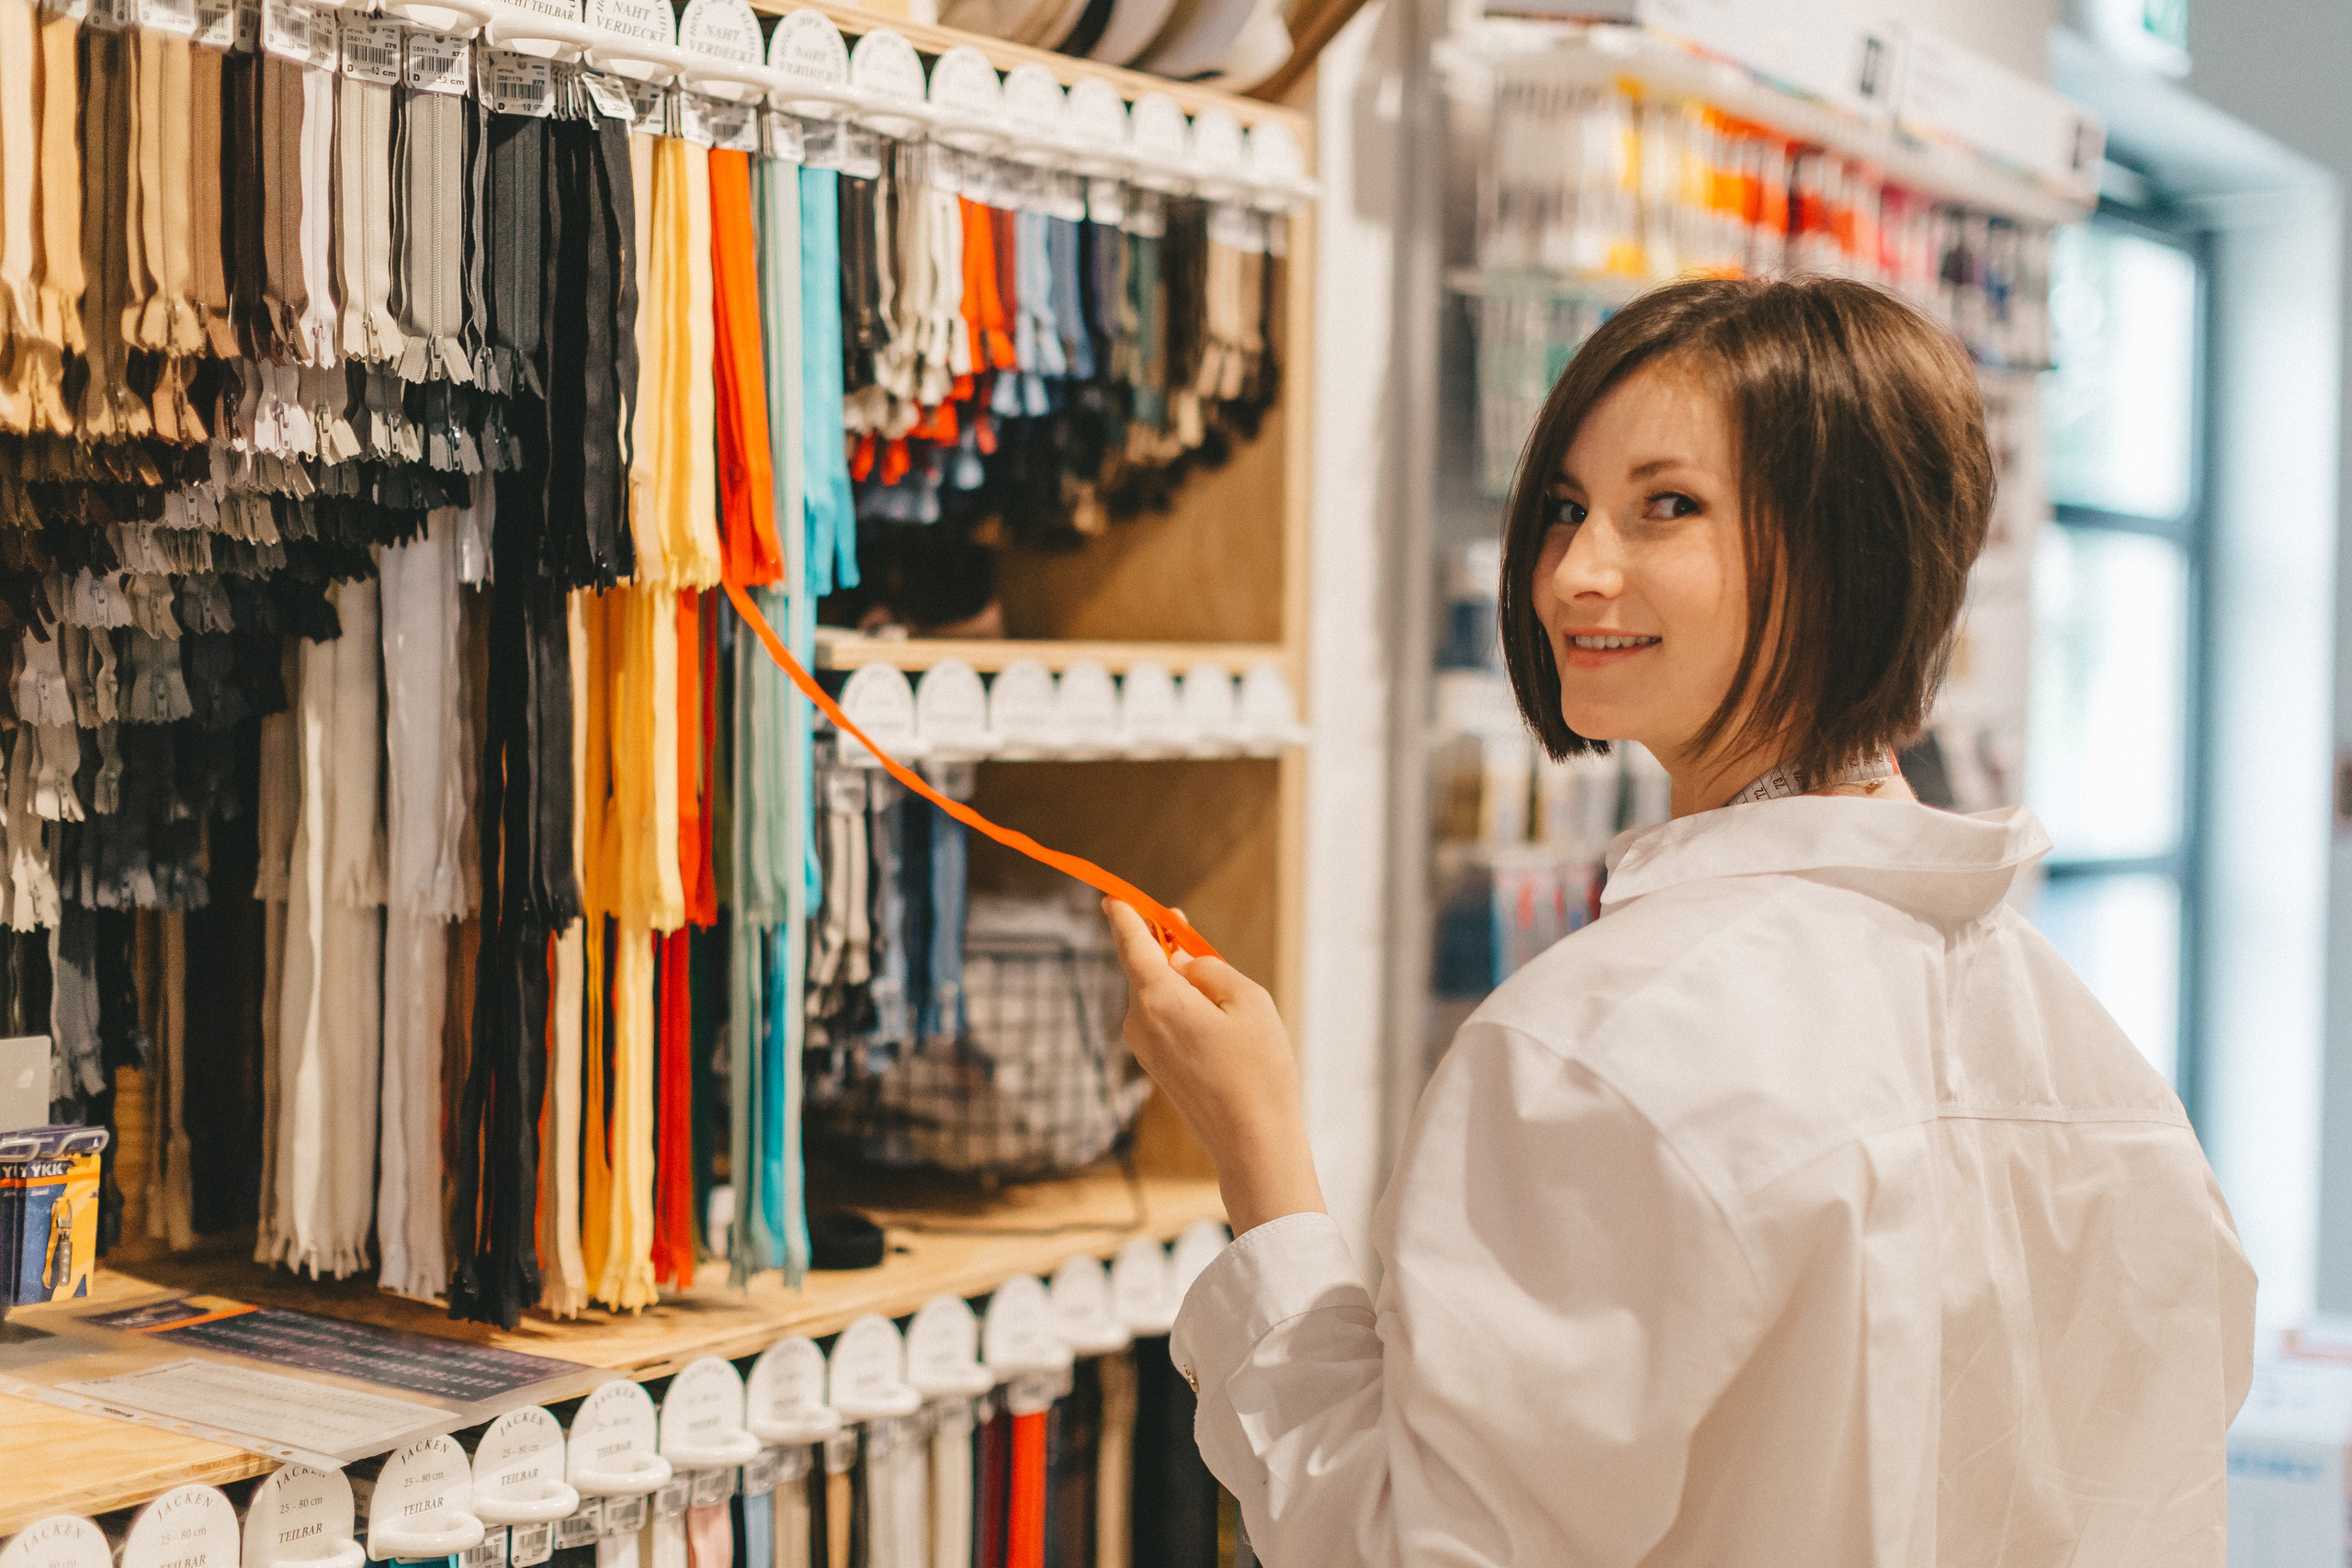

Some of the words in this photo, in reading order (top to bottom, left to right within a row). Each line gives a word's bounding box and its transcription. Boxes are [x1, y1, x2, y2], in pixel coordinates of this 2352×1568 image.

[532, 0, 574, 20] TEILBAR
[613, 1, 651, 21] NAHT
[596, 15, 667, 42] VERDECKT
[413, 45, 439, 54] 0561179
[347, 64, 354, 73] D
[413, 73, 421, 82] D
[498, 102, 505, 110] D
[1772, 777, 1785, 790] 73
[1754, 786, 1766, 800] 72
[30, 1163, 63, 1178] YKK
[401, 1438, 450, 1465] JACKEN
[404, 1477, 413, 1488] 25
[422, 1473, 431, 1483] 80
[432, 1472, 444, 1480] cm
[157, 1493, 213, 1521] JACKEN
[279, 1504, 289, 1514] 25
[299, 1498, 309, 1509] 80
[311, 1496, 322, 1506] cm
[403, 1496, 444, 1517] TEILBAR
[23, 1522, 86, 1553] JACKEN
[160, 1535, 171, 1546] 25
[181, 1529, 191, 1540] 80
[193, 1527, 207, 1537] cm
[278, 1522, 322, 1543] TEILBAR
